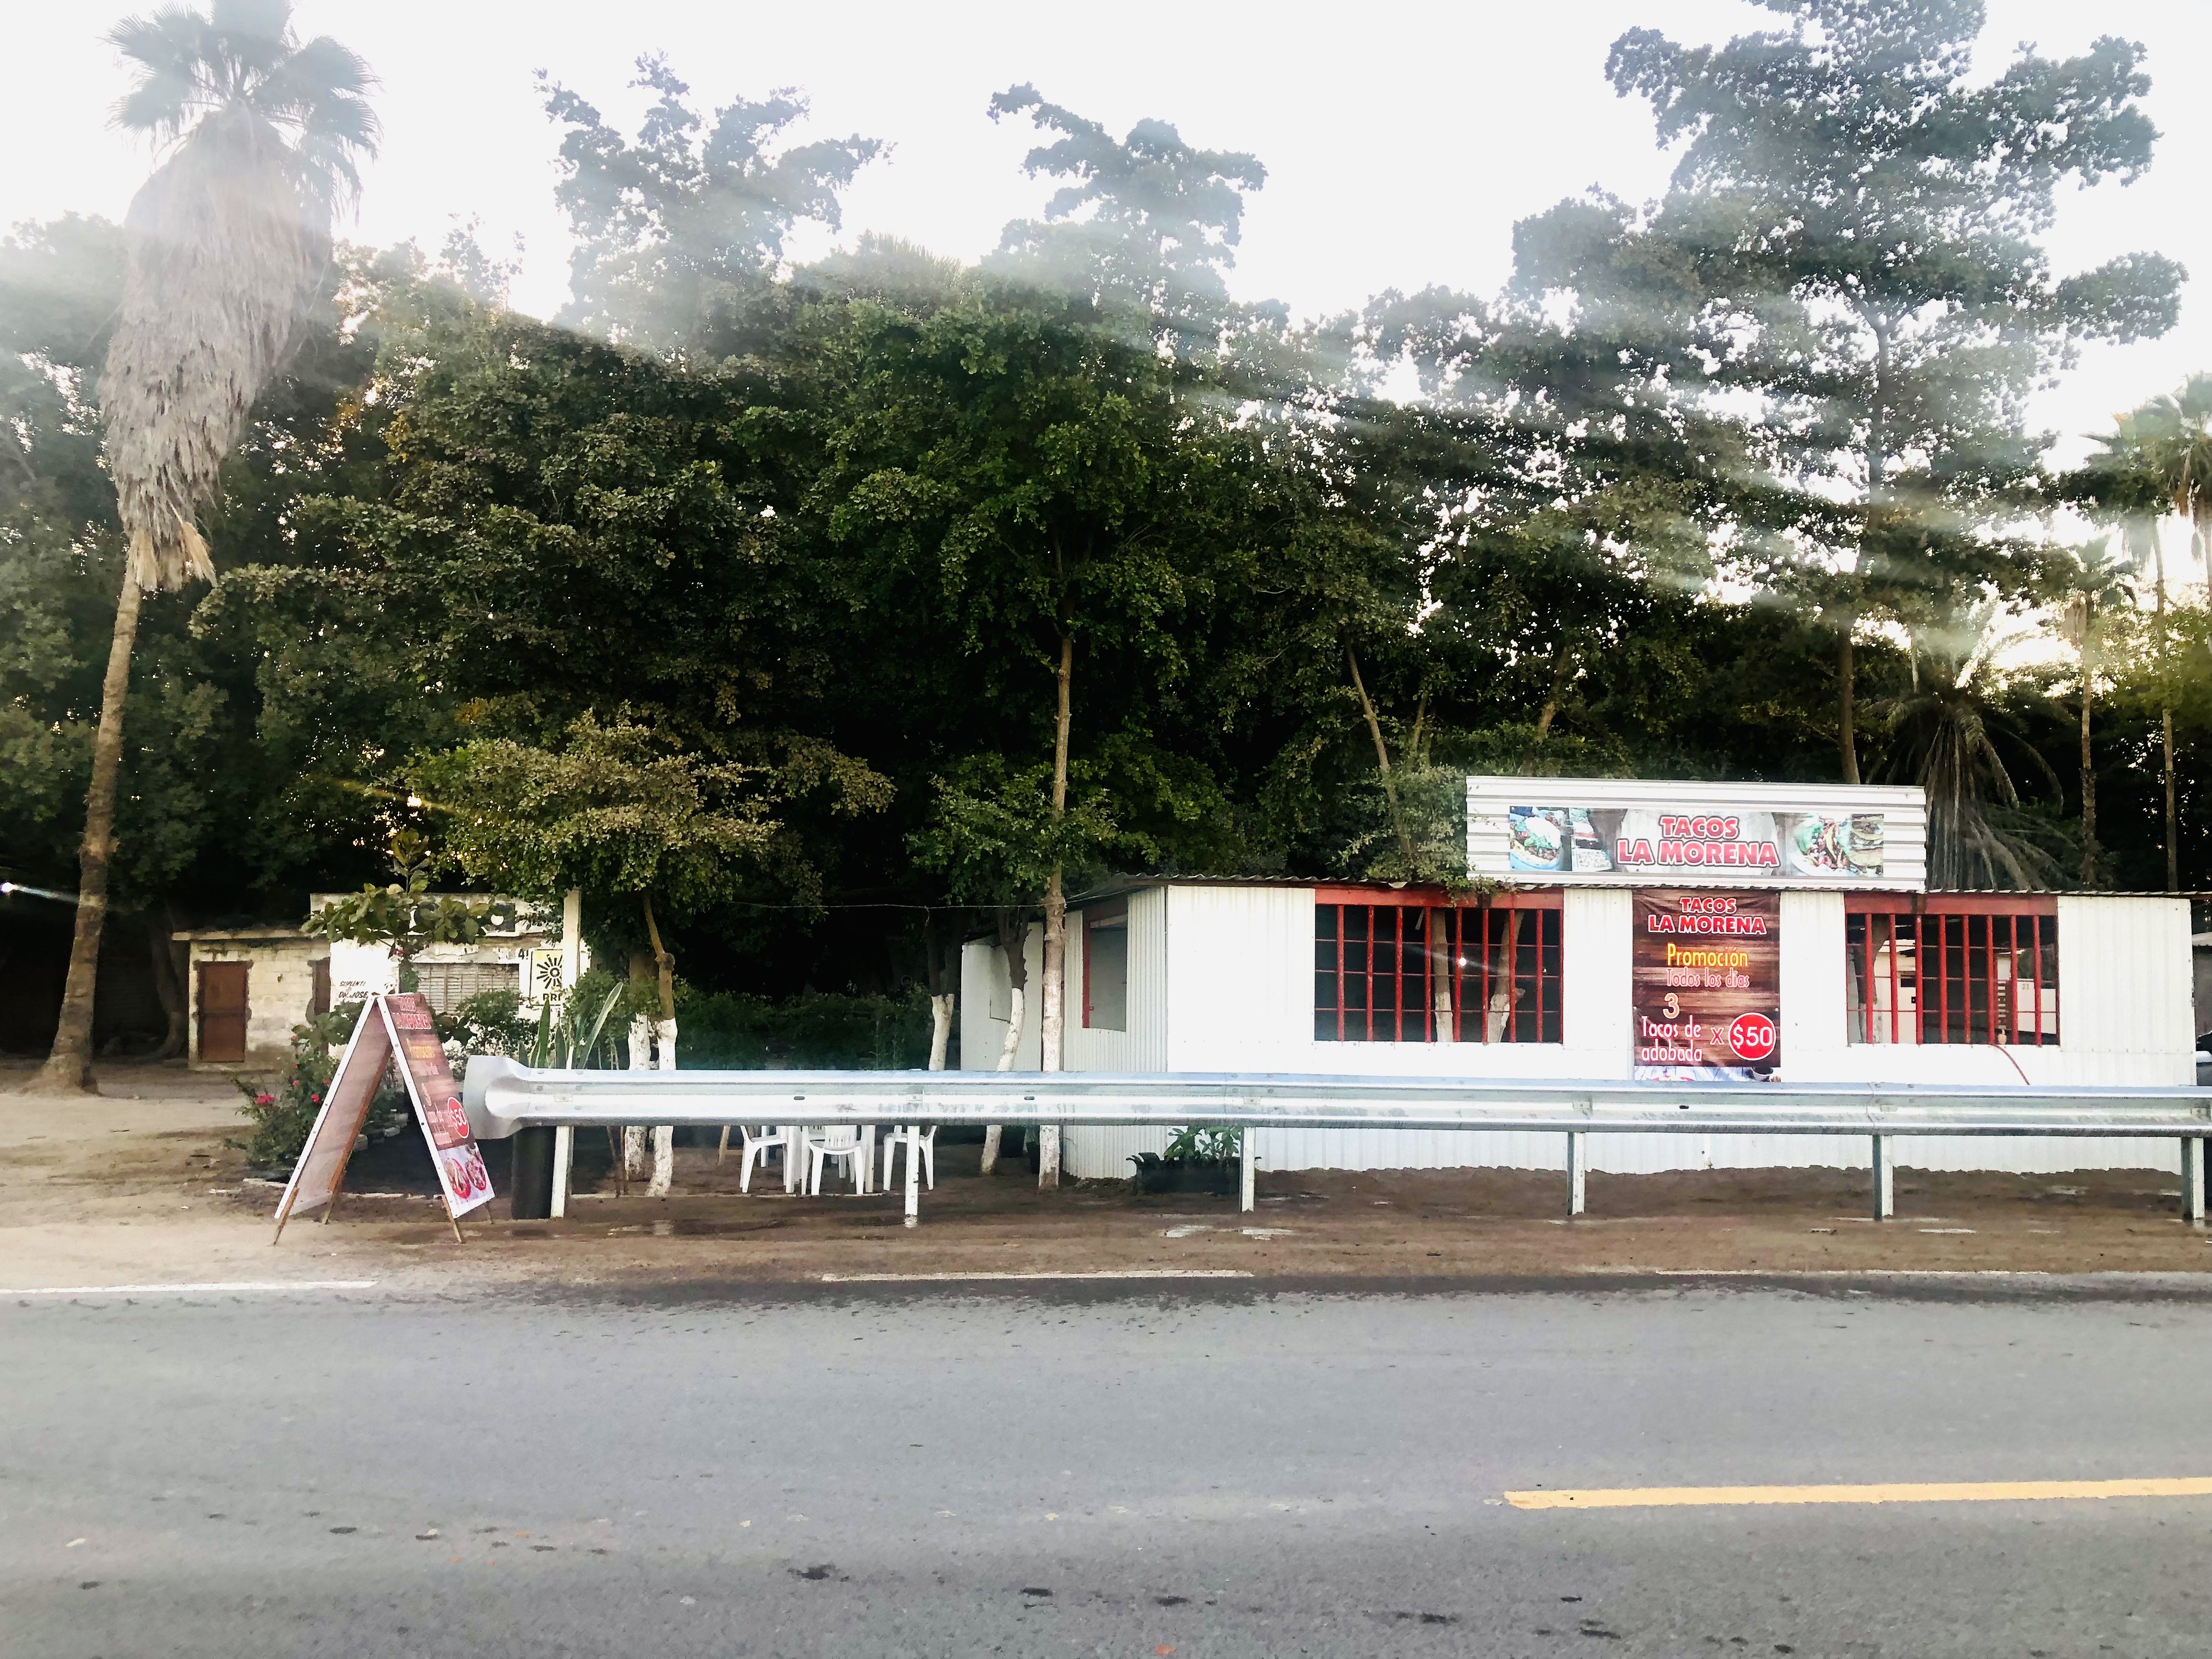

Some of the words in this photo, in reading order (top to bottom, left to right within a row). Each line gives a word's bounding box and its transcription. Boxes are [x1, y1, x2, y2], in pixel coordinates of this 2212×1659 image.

[1660, 815, 1739, 839] TACOS
[1617, 839, 1655, 865] LA
[1658, 840, 1780, 867] MORENA
[1680, 897, 1737, 914] TACOS
[1648, 915, 1675, 933] LA
[1678, 915, 1767, 935] MORENA
[1667, 943, 1748, 967] Promoción
[1666, 967, 1701, 987] Todos
[1705, 967, 1722, 987] los
[1725, 967, 1750, 988] días
[1663, 992, 1680, 1019] 3
[1641, 1015, 1678, 1038] Tacos
[1684, 1015, 1701, 1038] de
[1733, 1024, 1773, 1049] $50
[1641, 1038, 1702, 1062] adobada
[450, 1107, 467, 1130] $50
